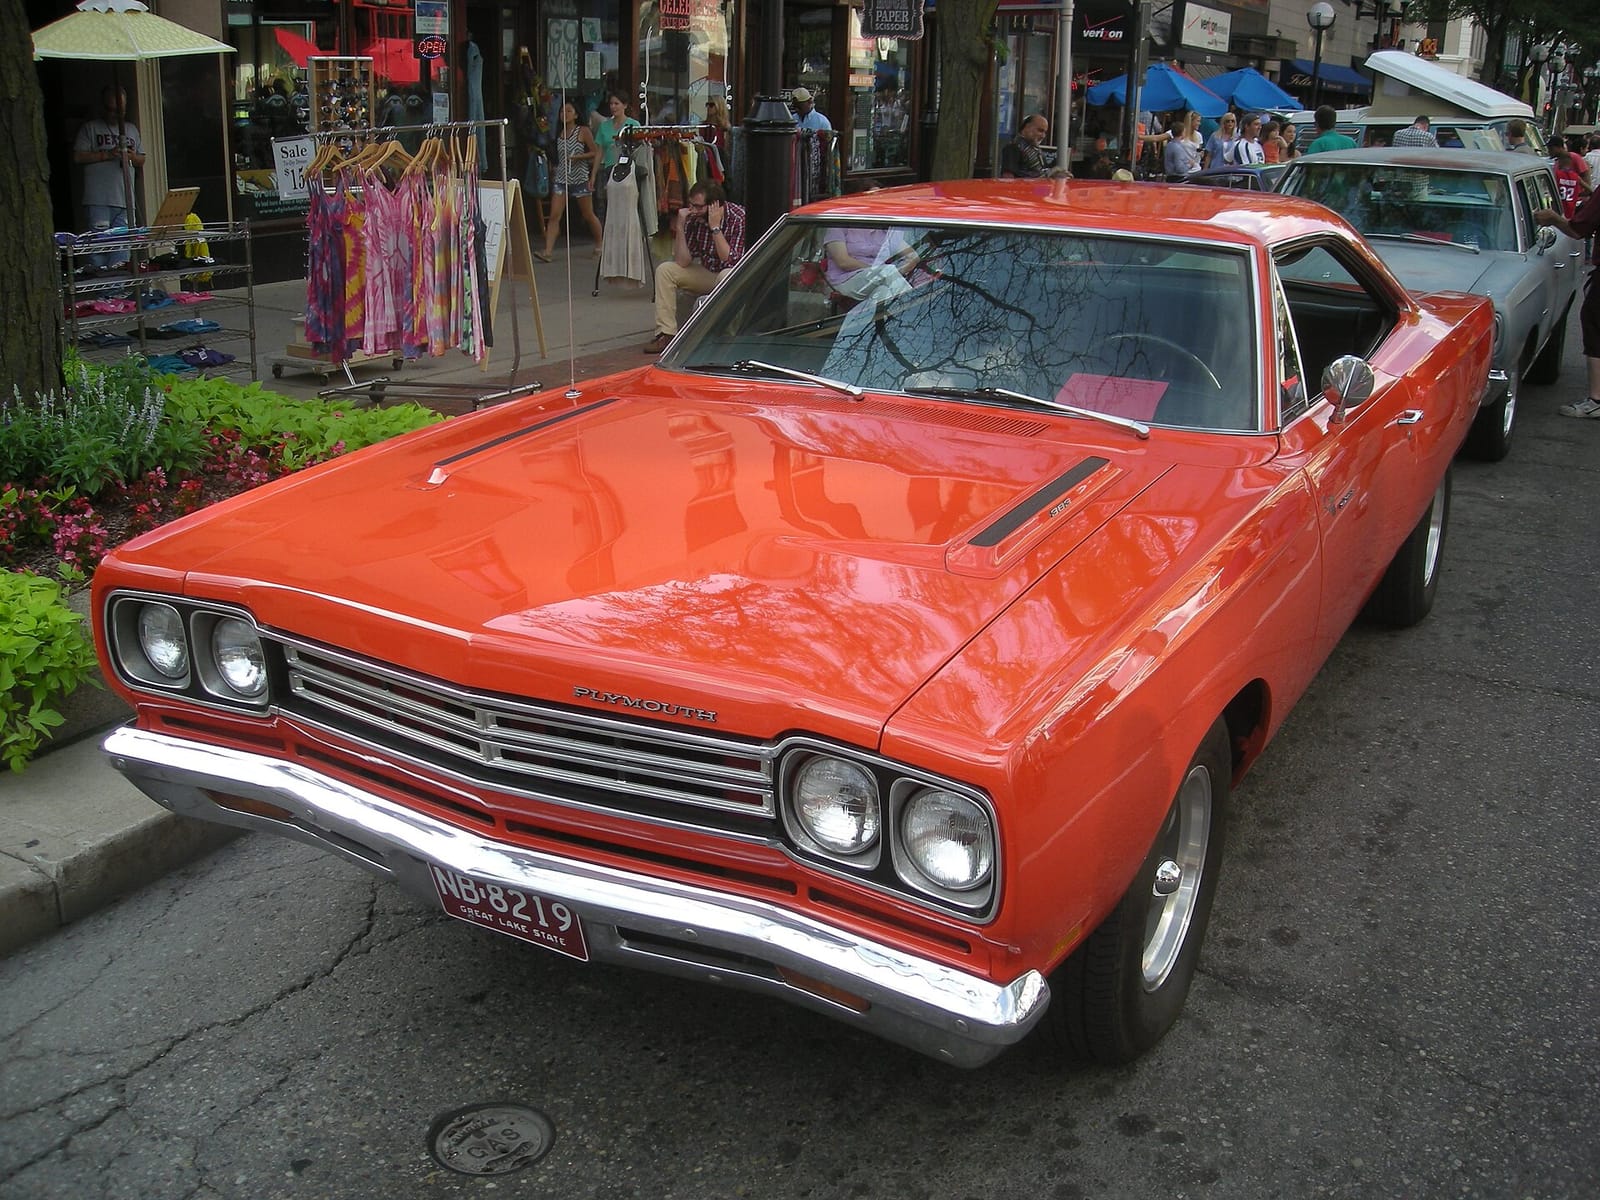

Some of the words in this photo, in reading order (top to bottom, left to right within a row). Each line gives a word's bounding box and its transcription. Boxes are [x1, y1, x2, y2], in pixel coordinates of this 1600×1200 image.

[876, 10, 909, 22] PAPER
[548, 20, 578, 41] GO
[875, 23, 909, 31] SCISSORS
[1083, 28, 1123, 41] verizon
[419, 41, 447, 53] OPEN
[280, 144, 308, 159] Sale
[1559, 186, 1575, 201] 32
[573, 686, 717, 723] PLYMOUTH
[460, 905, 494, 922] GREAT
[499, 918, 529, 934] LAKE
[533, 929, 567, 946] STATE
[467, 1128, 521, 1158] GAS
